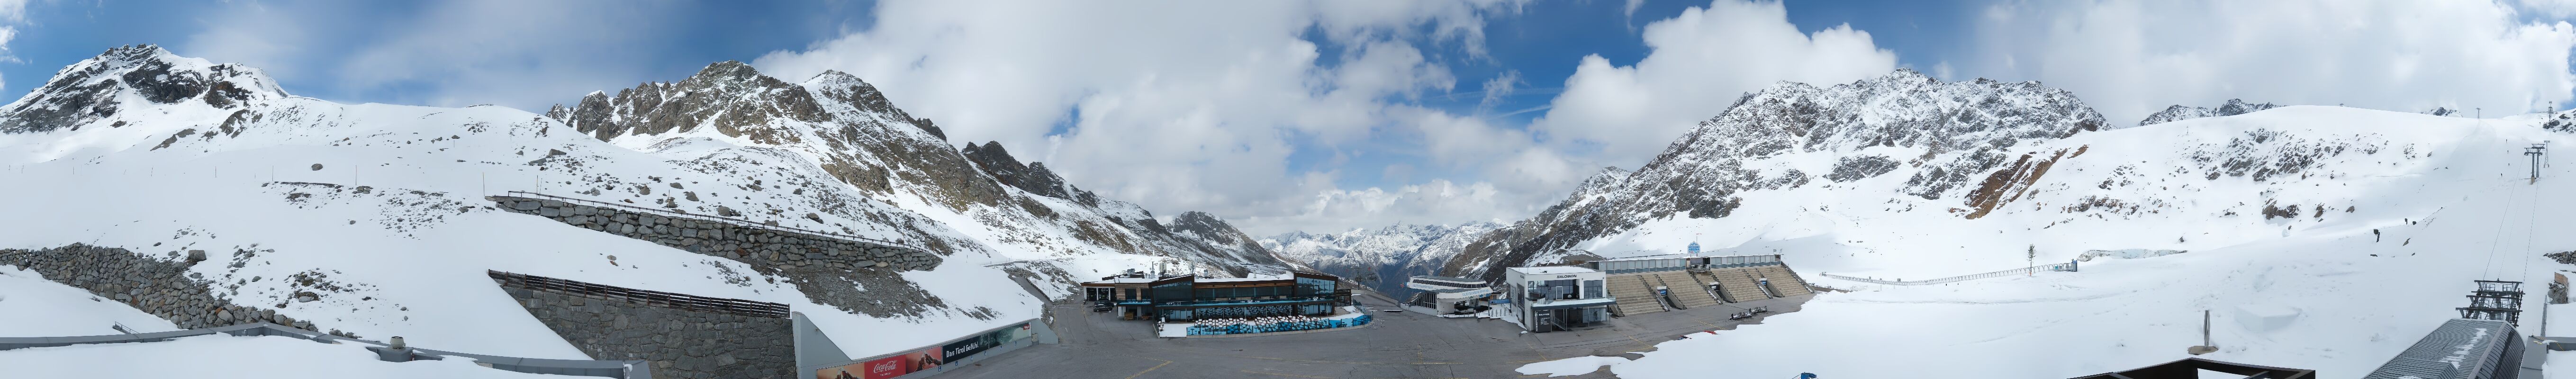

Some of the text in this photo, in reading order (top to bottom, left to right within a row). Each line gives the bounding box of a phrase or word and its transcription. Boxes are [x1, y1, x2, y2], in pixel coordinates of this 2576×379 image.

[955, 345, 965, 355] Tirol
[966, 341, 979, 352] Gefühl
[873, 360, 897, 373] Coca-Cola
